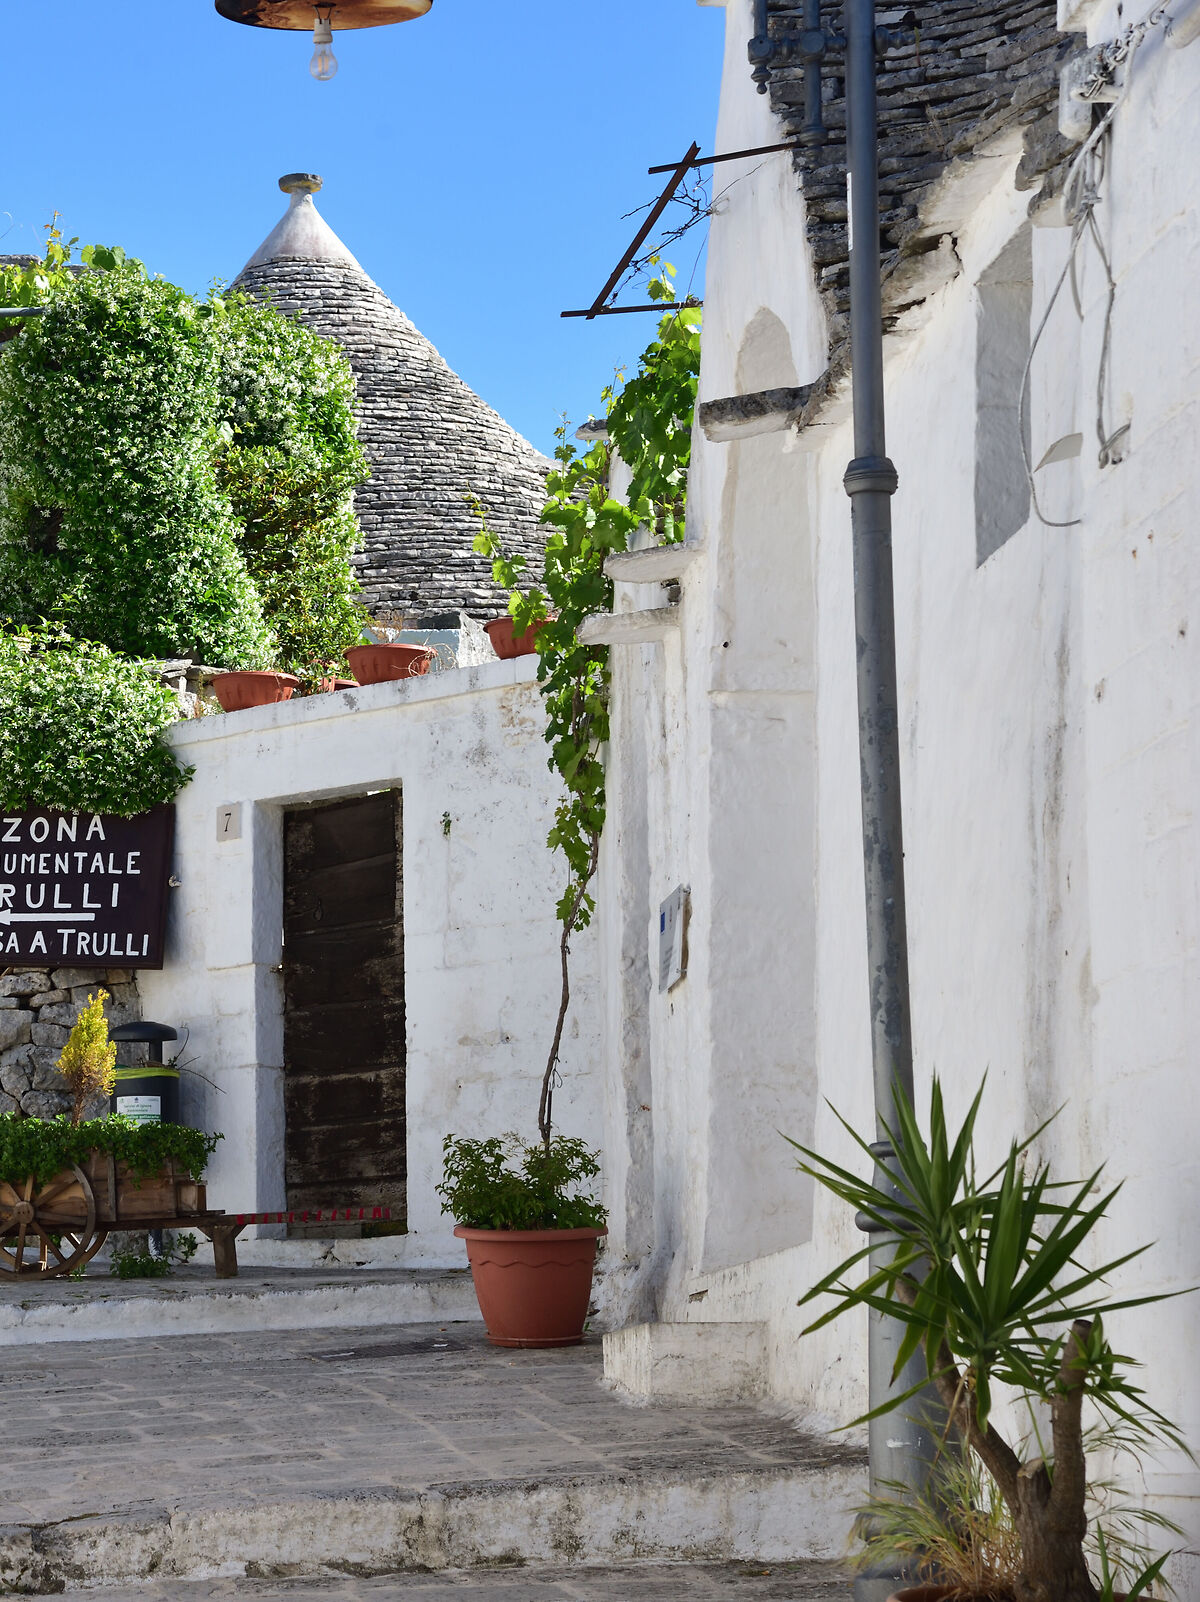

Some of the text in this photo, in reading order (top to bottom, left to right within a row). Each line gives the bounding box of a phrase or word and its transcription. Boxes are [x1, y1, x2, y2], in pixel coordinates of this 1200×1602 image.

[2, 815, 105, 842] ZONA
[224, 812, 232, 833] 7
[30, 931, 47, 953] A
[57, 929, 148, 956] TRULLI
